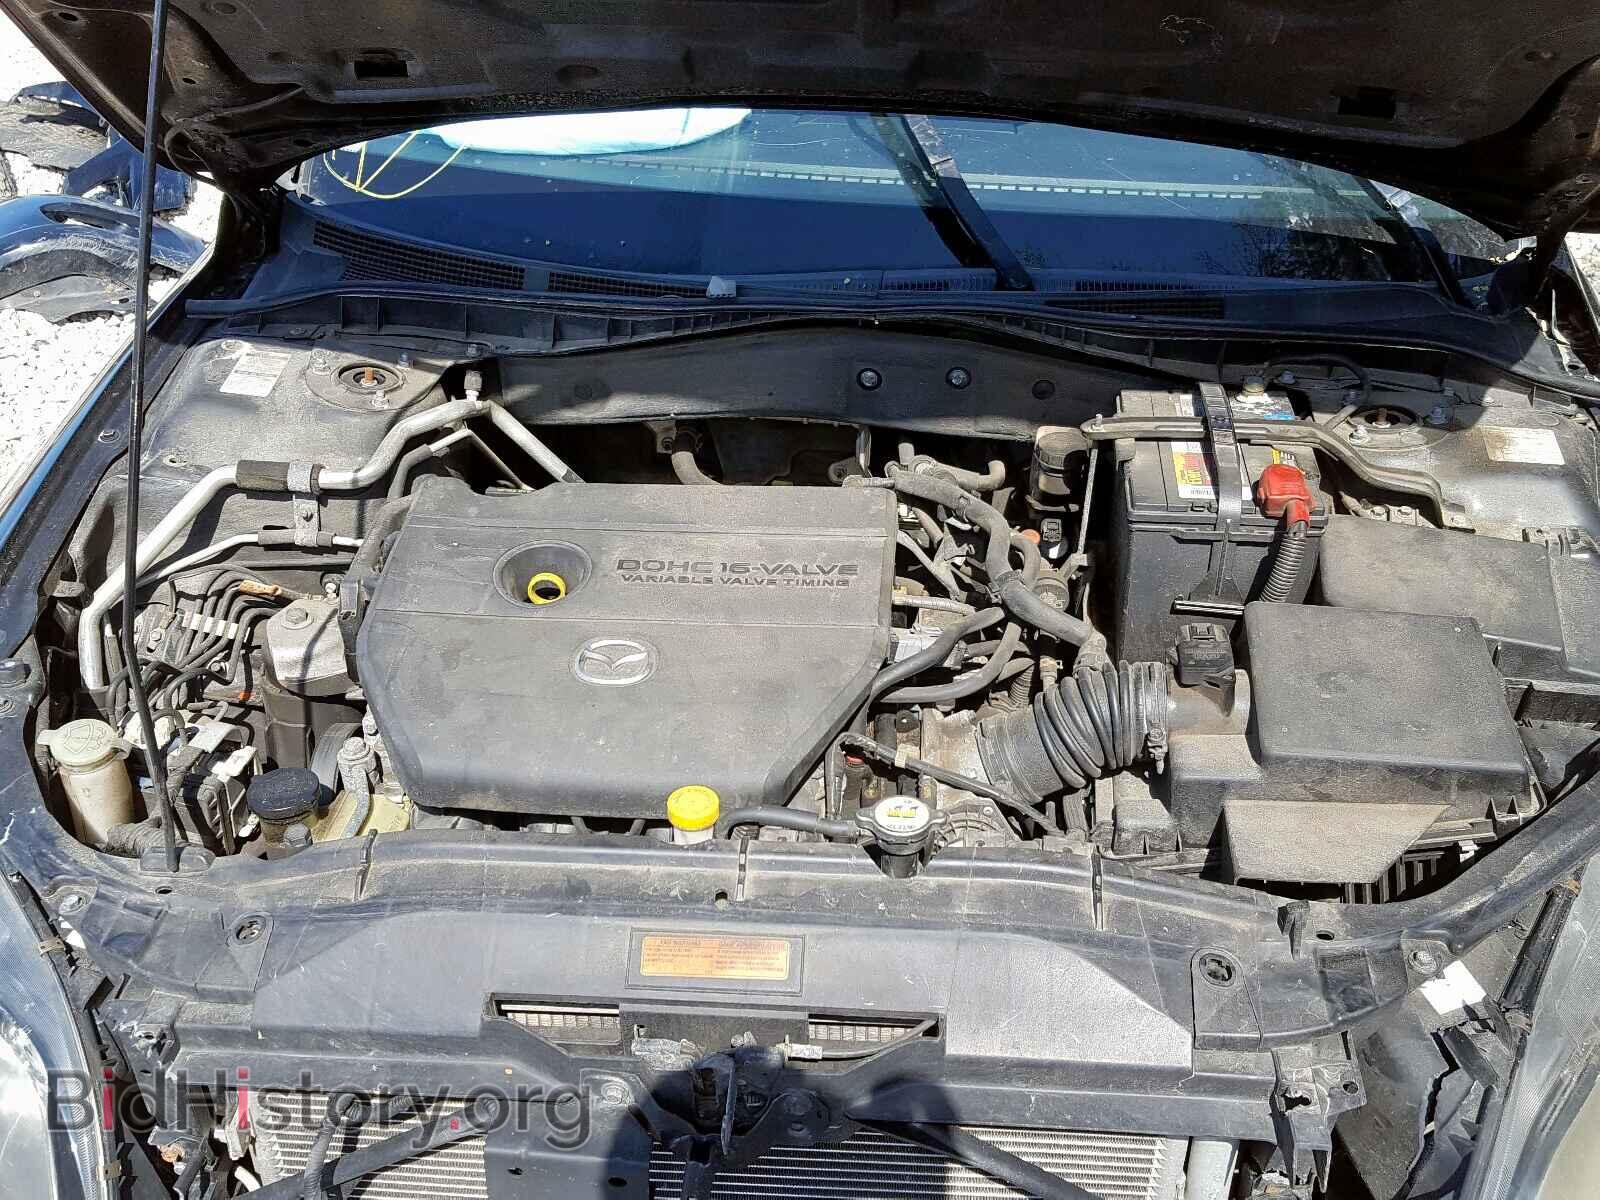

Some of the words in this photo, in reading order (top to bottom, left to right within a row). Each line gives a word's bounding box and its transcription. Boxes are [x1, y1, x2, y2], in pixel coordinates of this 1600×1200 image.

[616, 559, 714, 574] DOHC
[719, 562, 859, 576] 16-VALVE
[621, 574, 714, 585] VARIABLE
[719, 577, 777, 586] VALVE
[783, 578, 850, 587] TIMING
